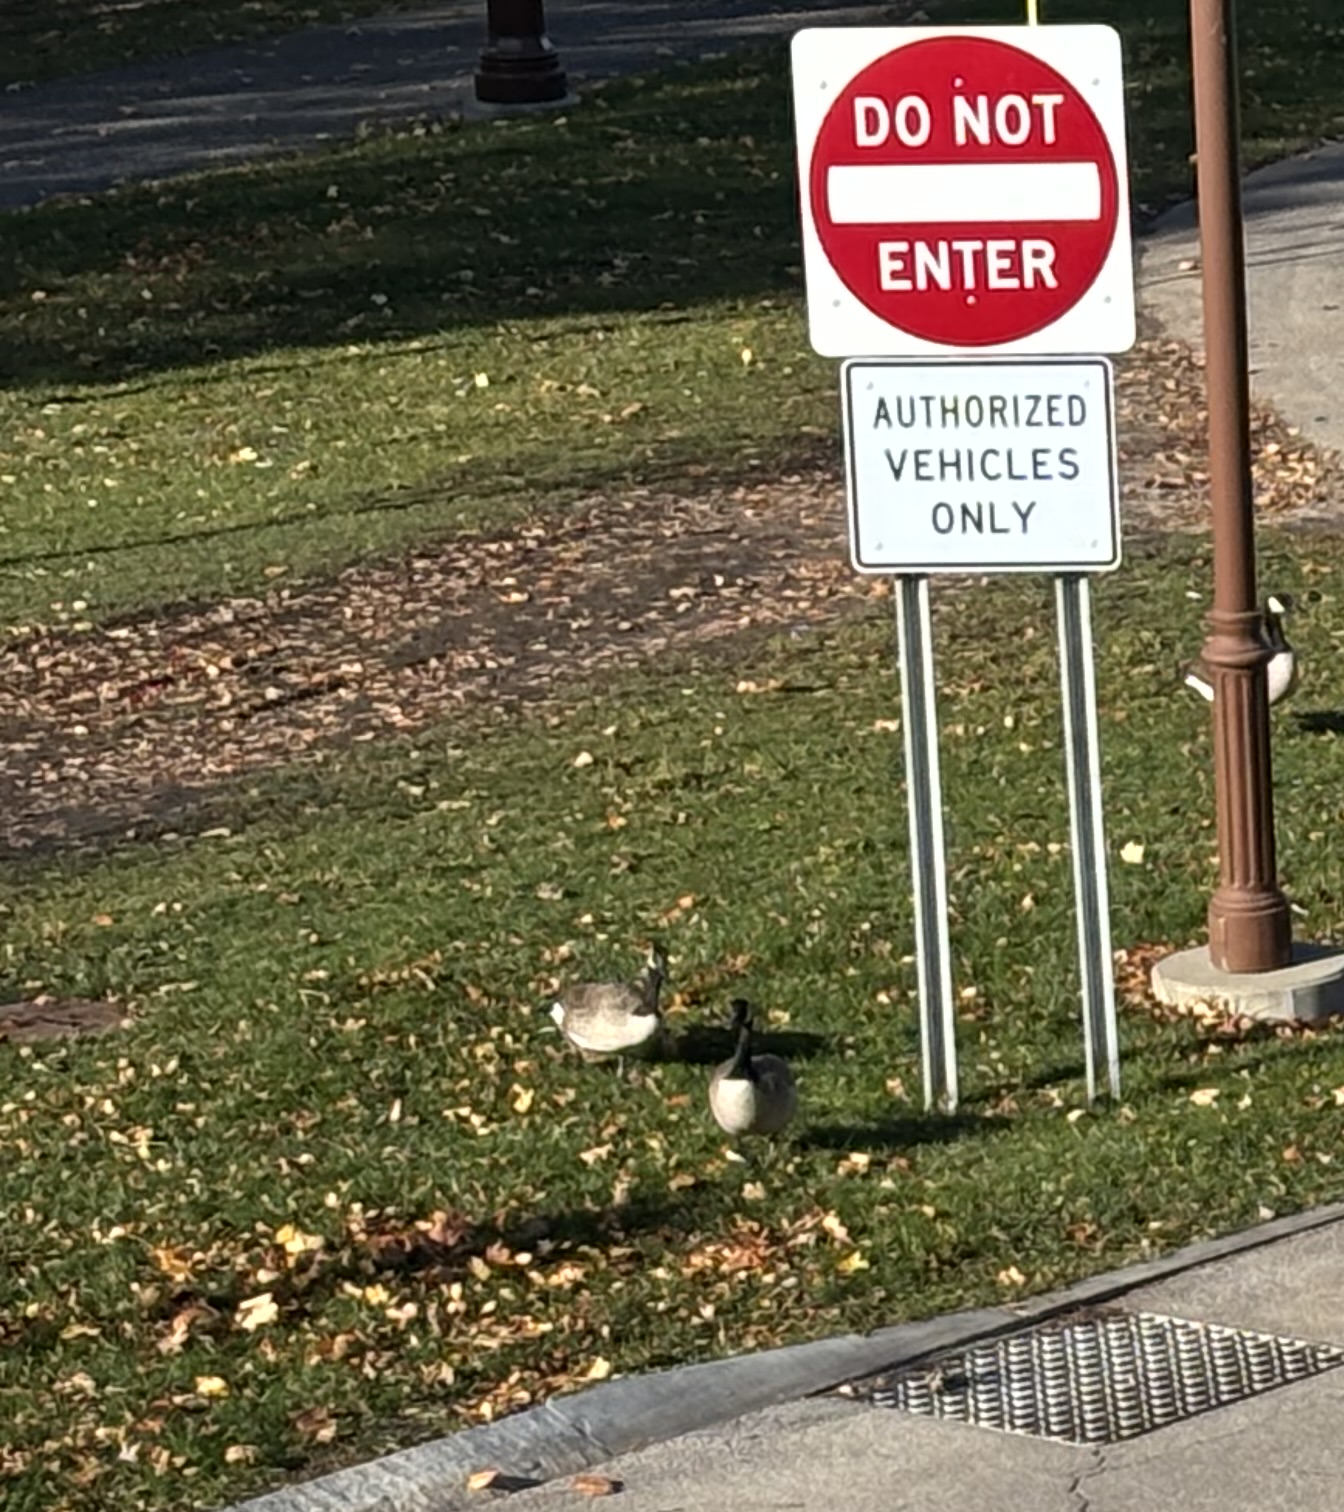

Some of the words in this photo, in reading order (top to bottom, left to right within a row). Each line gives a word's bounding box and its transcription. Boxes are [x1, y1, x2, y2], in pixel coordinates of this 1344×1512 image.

[854, 96, 930, 146] DO
[954, 95, 1063, 145] NOT
[879, 240, 1057, 290] ENTER
[873, 394, 1087, 429] AUTHORIZED
[885, 447, 1080, 482] VEHICLES
[931, 501, 1036, 535] ONLY
